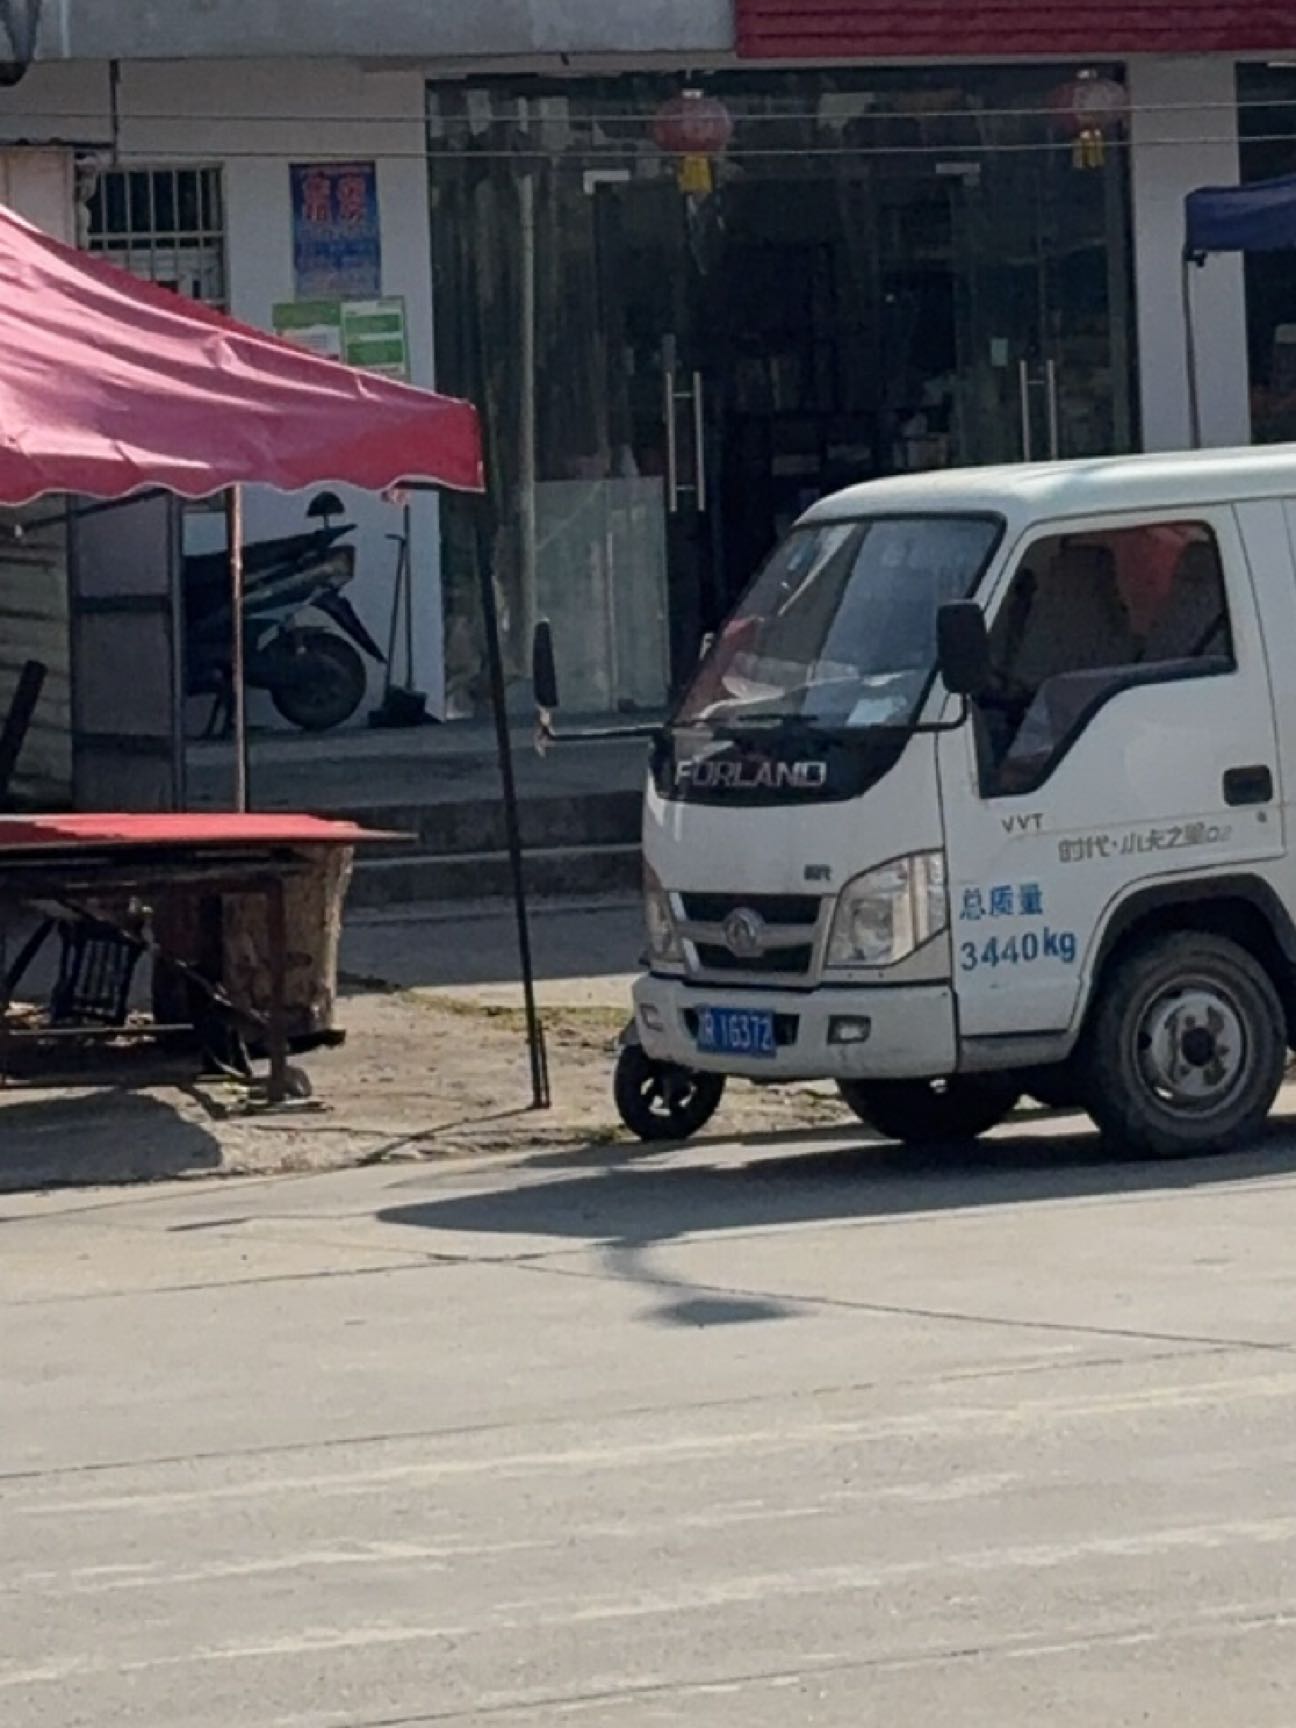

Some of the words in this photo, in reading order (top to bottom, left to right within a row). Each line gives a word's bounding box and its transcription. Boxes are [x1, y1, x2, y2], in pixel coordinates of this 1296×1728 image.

[674, 761, 828, 788] FORLAND
[1001, 812, 1044, 833] VVT
[959, 881, 1044, 921] 总质量
[960, 926, 1077, 971] 3440kg
